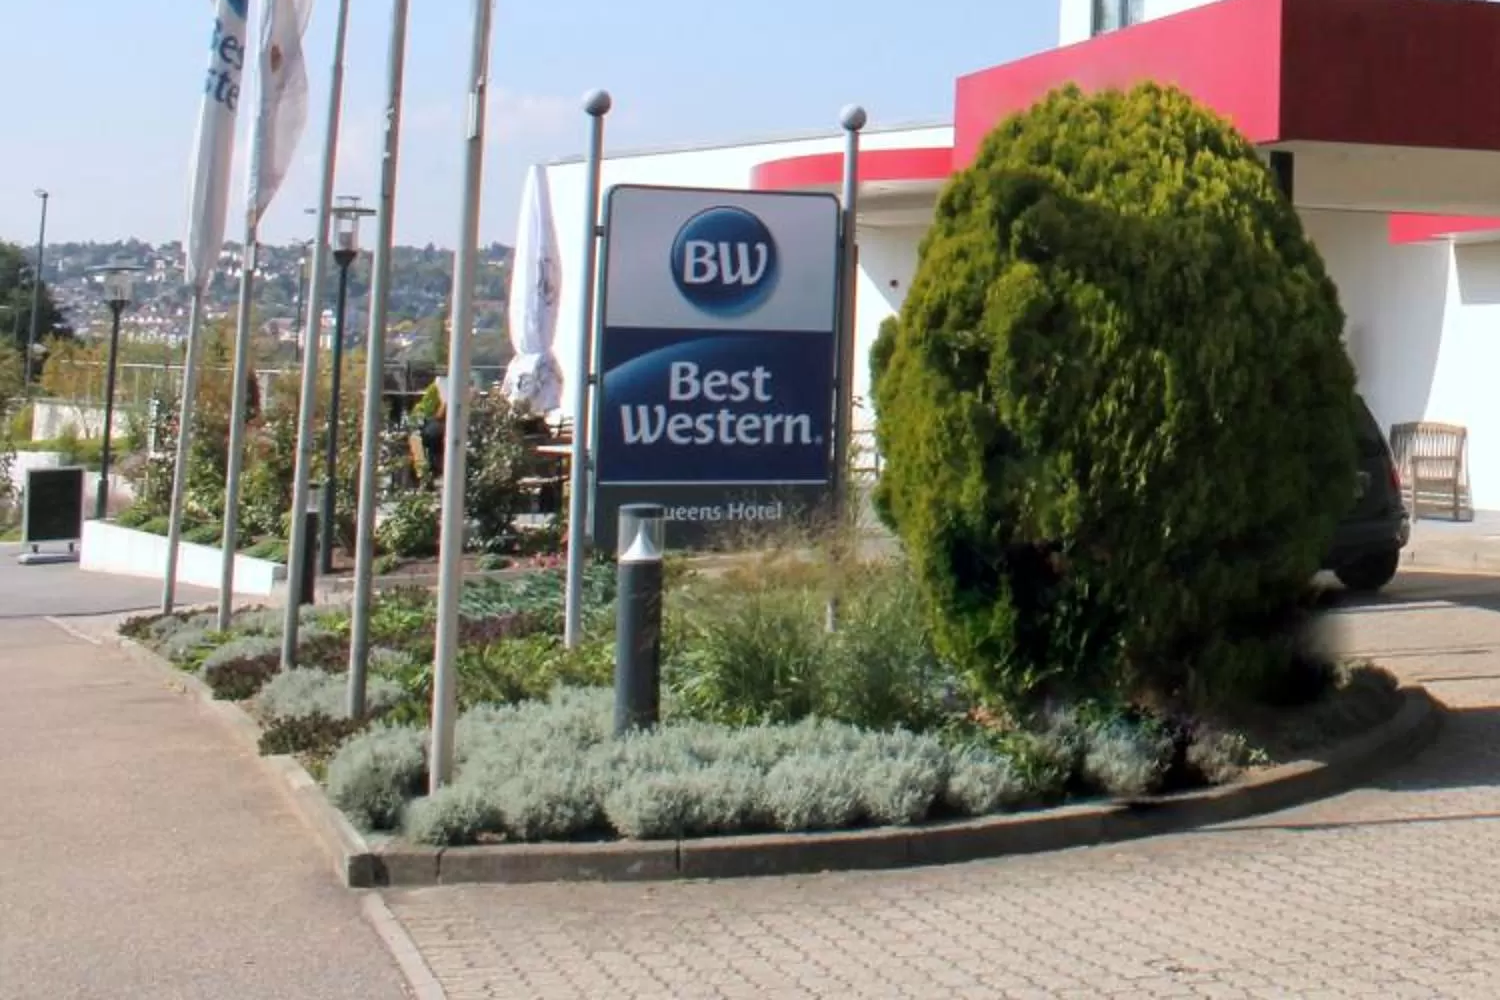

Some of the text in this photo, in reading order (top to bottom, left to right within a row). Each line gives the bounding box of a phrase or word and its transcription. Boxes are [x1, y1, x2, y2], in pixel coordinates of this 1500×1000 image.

[683, 240, 768, 285] BW
[669, 361, 772, 402] Best
[662, 501, 783, 521] ueens Hotel
